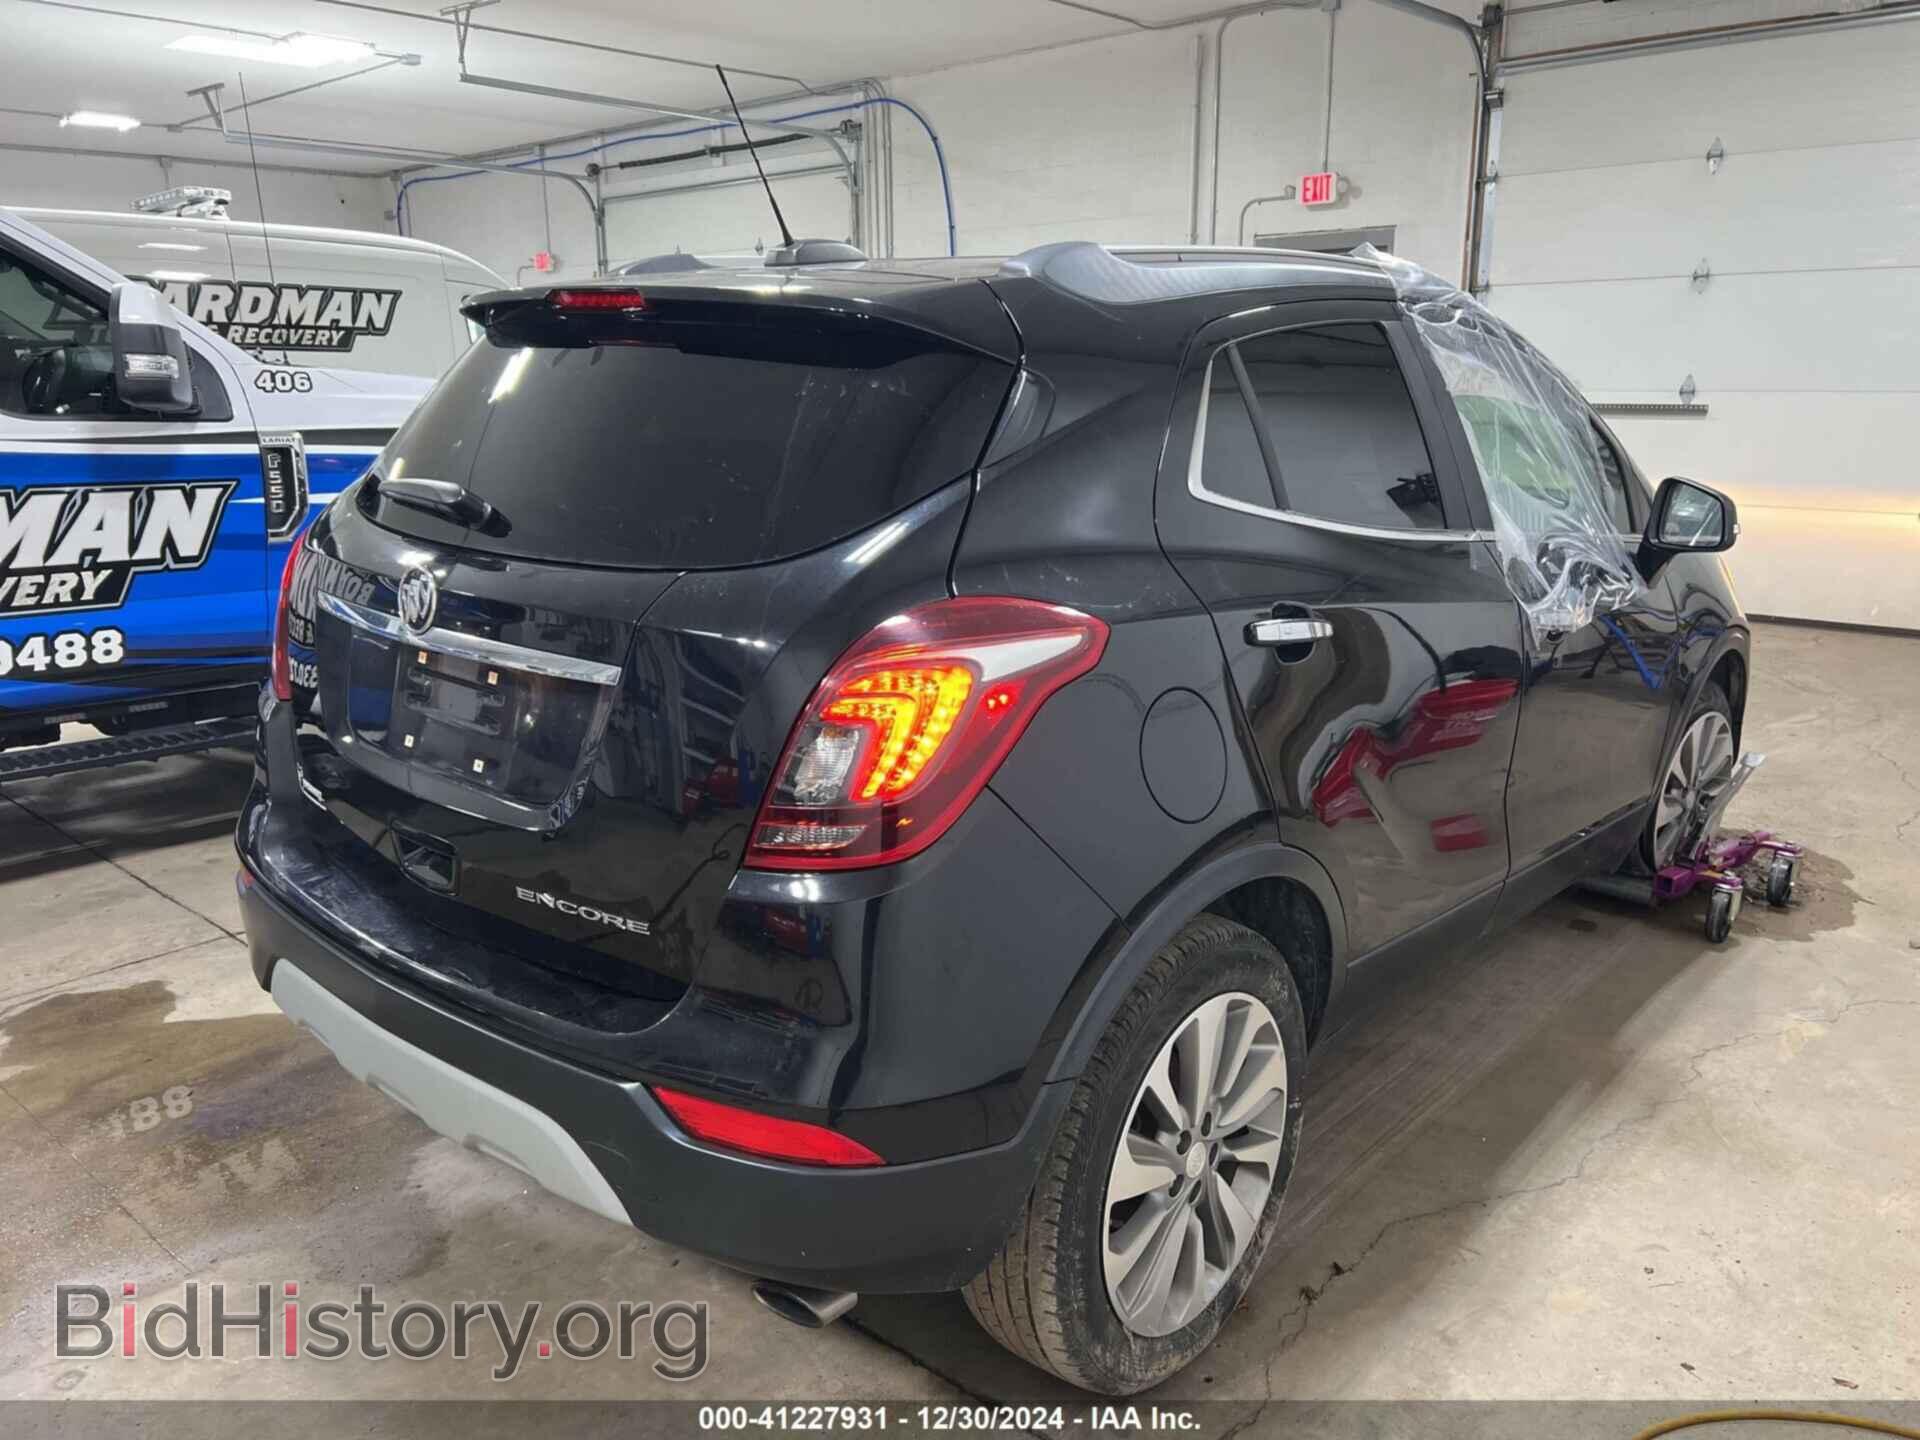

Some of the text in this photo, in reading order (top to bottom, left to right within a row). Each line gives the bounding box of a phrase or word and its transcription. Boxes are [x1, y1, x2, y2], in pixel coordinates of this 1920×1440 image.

[1303, 174, 1332, 203] EXIT
[227, 325, 346, 346] RECOVERY
[255, 370, 312, 392] 406
[515, 886, 651, 936] ENCORE
